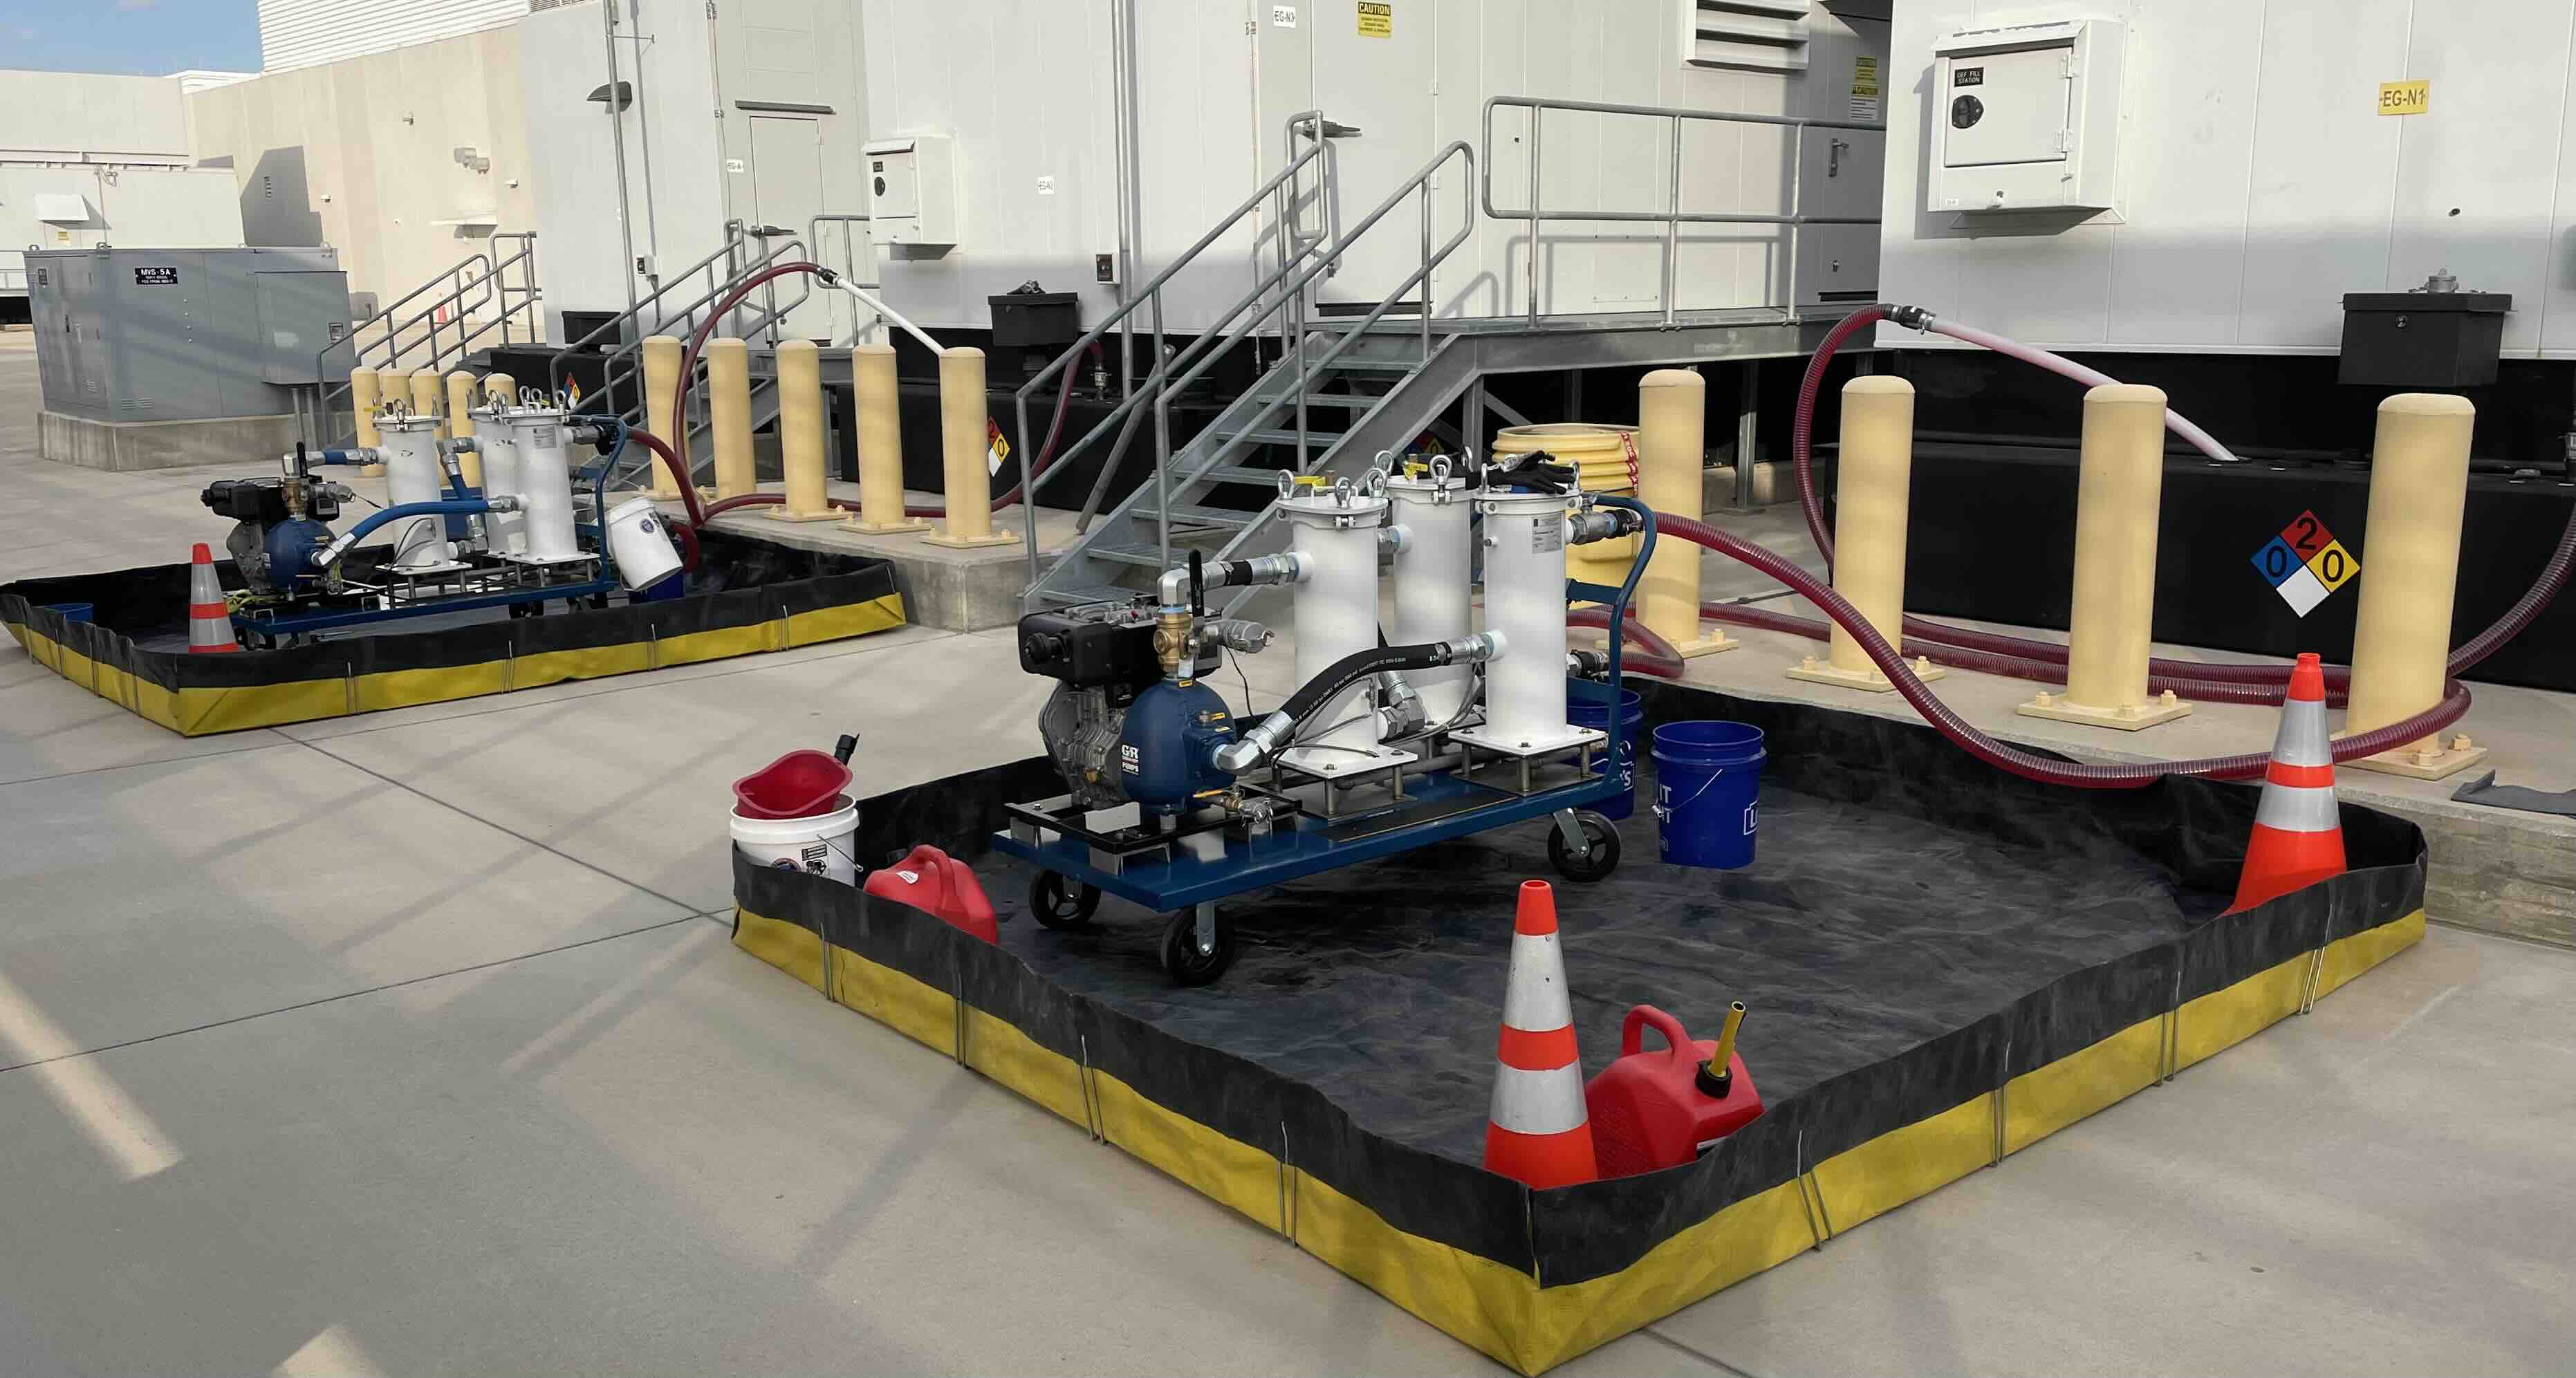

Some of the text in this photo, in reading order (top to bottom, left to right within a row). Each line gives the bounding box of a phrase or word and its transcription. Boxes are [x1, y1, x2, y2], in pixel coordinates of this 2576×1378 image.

[1359, 3, 1390, 15] CAUTION
[2384, 88, 2425, 106] EG-N1
[998, 438, 1004, 456] 0
[2296, 518, 2317, 550] 2
[2266, 546, 2286, 577] 0
[2322, 550, 2344, 582] 0
[1122, 744, 1139, 759] GR
